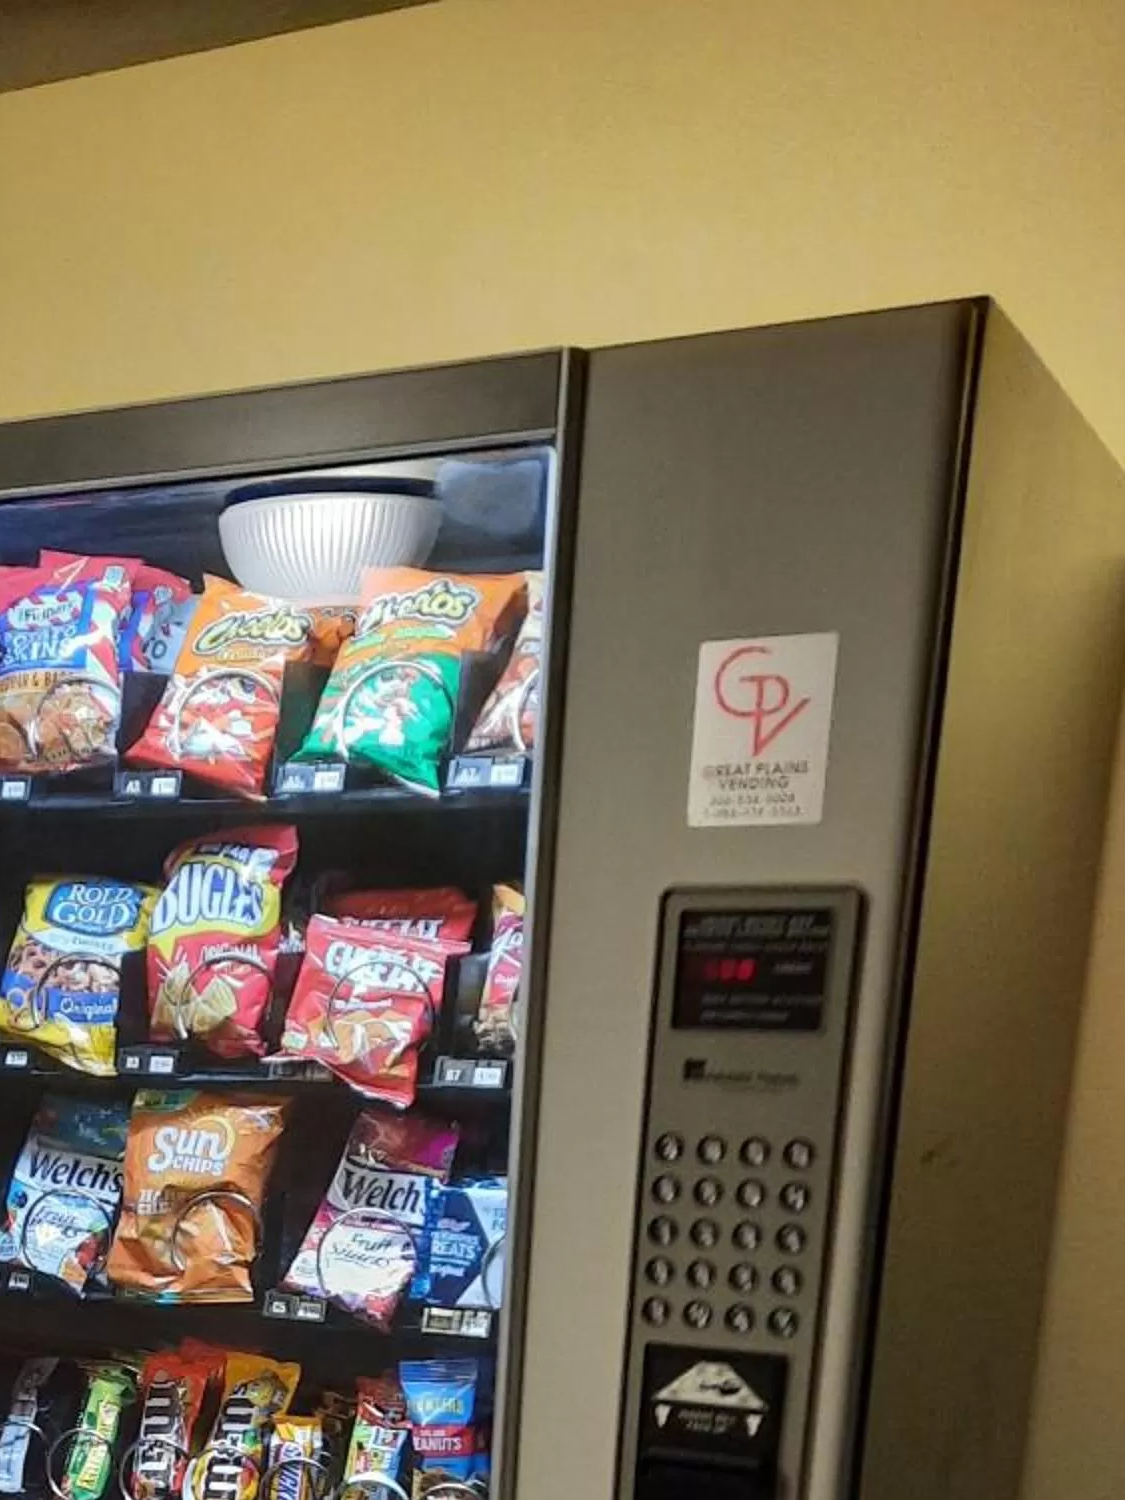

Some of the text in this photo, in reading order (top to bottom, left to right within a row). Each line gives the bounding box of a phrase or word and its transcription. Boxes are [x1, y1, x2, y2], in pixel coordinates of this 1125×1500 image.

[718, 775, 790, 791] VENDING
[68, 883, 134, 905] ROLD
[53, 901, 131, 929] GOLD
[29, 1152, 123, 1193] Welch's
[172, 1154, 224, 1177] CHIPS
[342, 1167, 425, 1216] Welch
